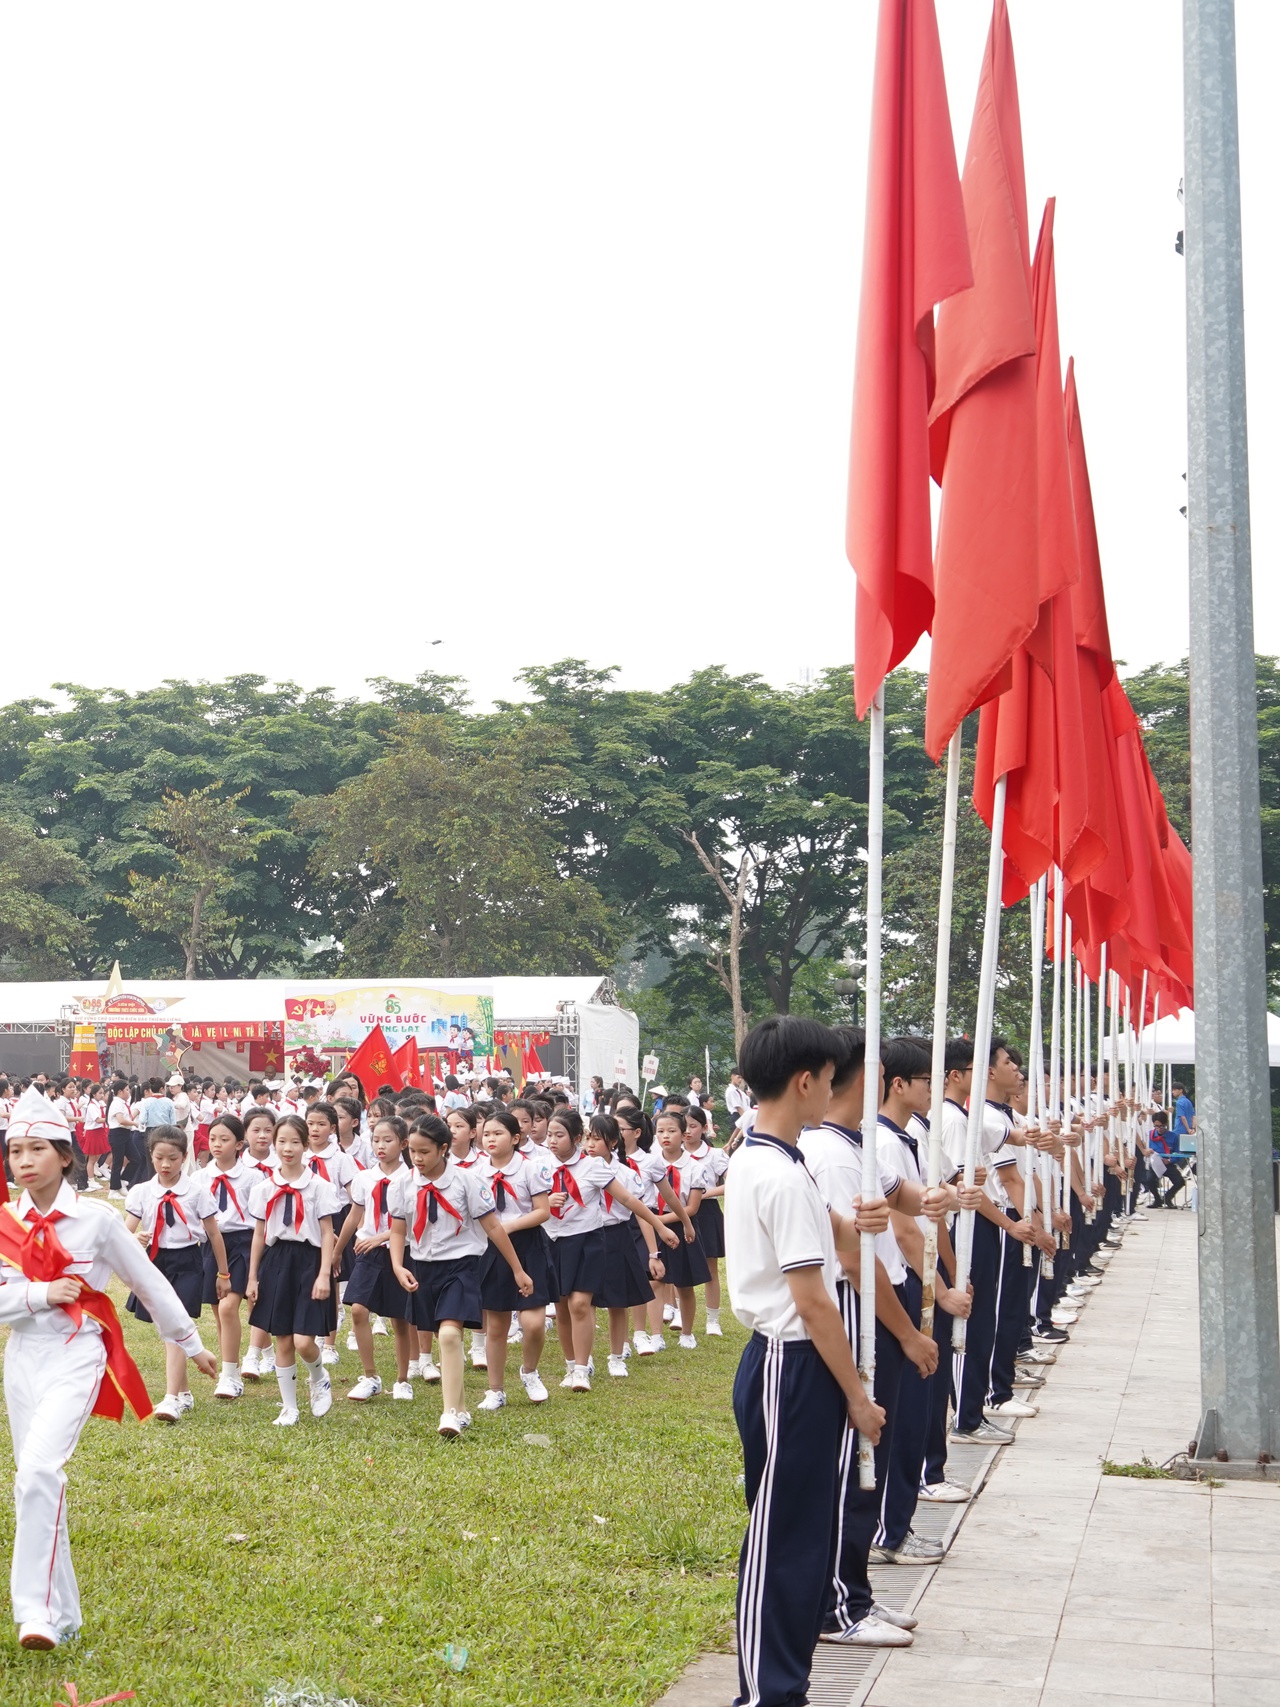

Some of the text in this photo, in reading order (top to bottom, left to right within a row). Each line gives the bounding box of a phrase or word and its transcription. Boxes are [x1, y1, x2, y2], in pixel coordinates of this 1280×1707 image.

[385, 999, 401, 1014] 85
[360, 1013, 427, 1023] VỮNG BƯỚC
[108, 1026, 123, 1040] ĐỘC
[124, 1026, 139, 1040] LẬP
